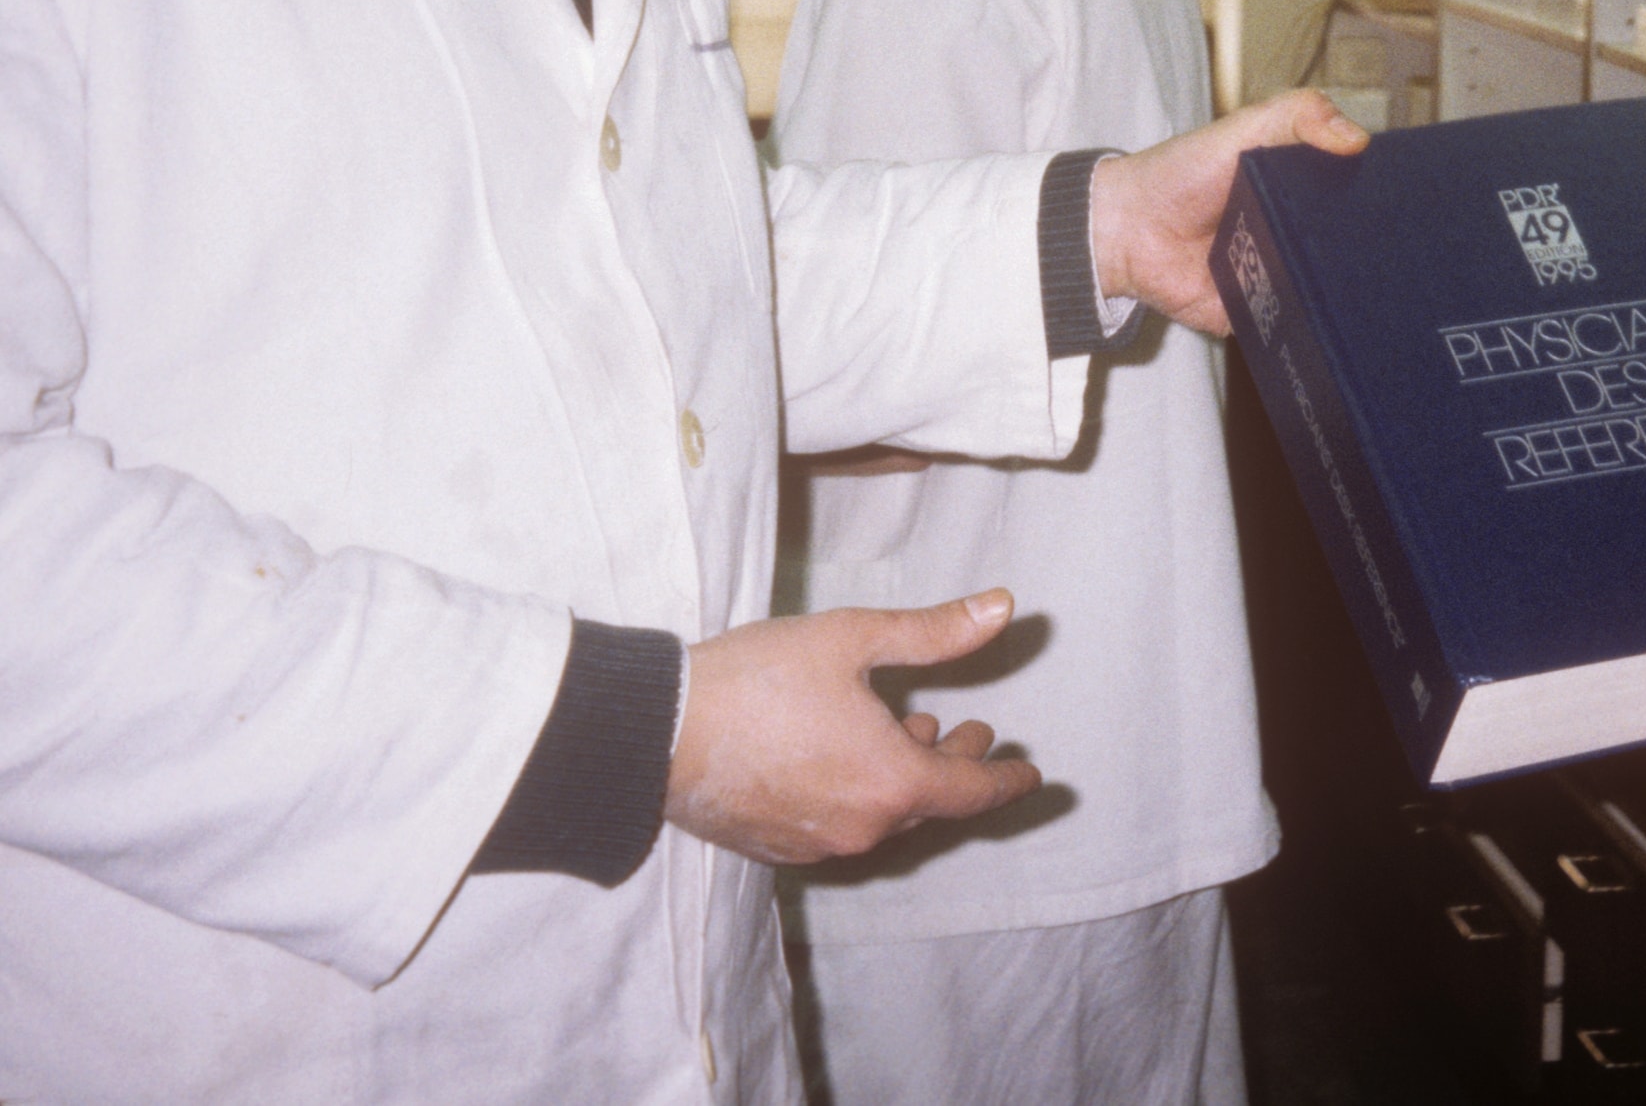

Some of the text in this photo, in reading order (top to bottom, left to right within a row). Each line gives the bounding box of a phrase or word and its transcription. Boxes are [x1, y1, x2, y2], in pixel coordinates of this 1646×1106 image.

[1498, 184, 1562, 213] PDR
[1521, 209, 1570, 245] 49
[1527, 244, 1586, 260] EDITION
[1531, 257, 1597, 286] 1995
